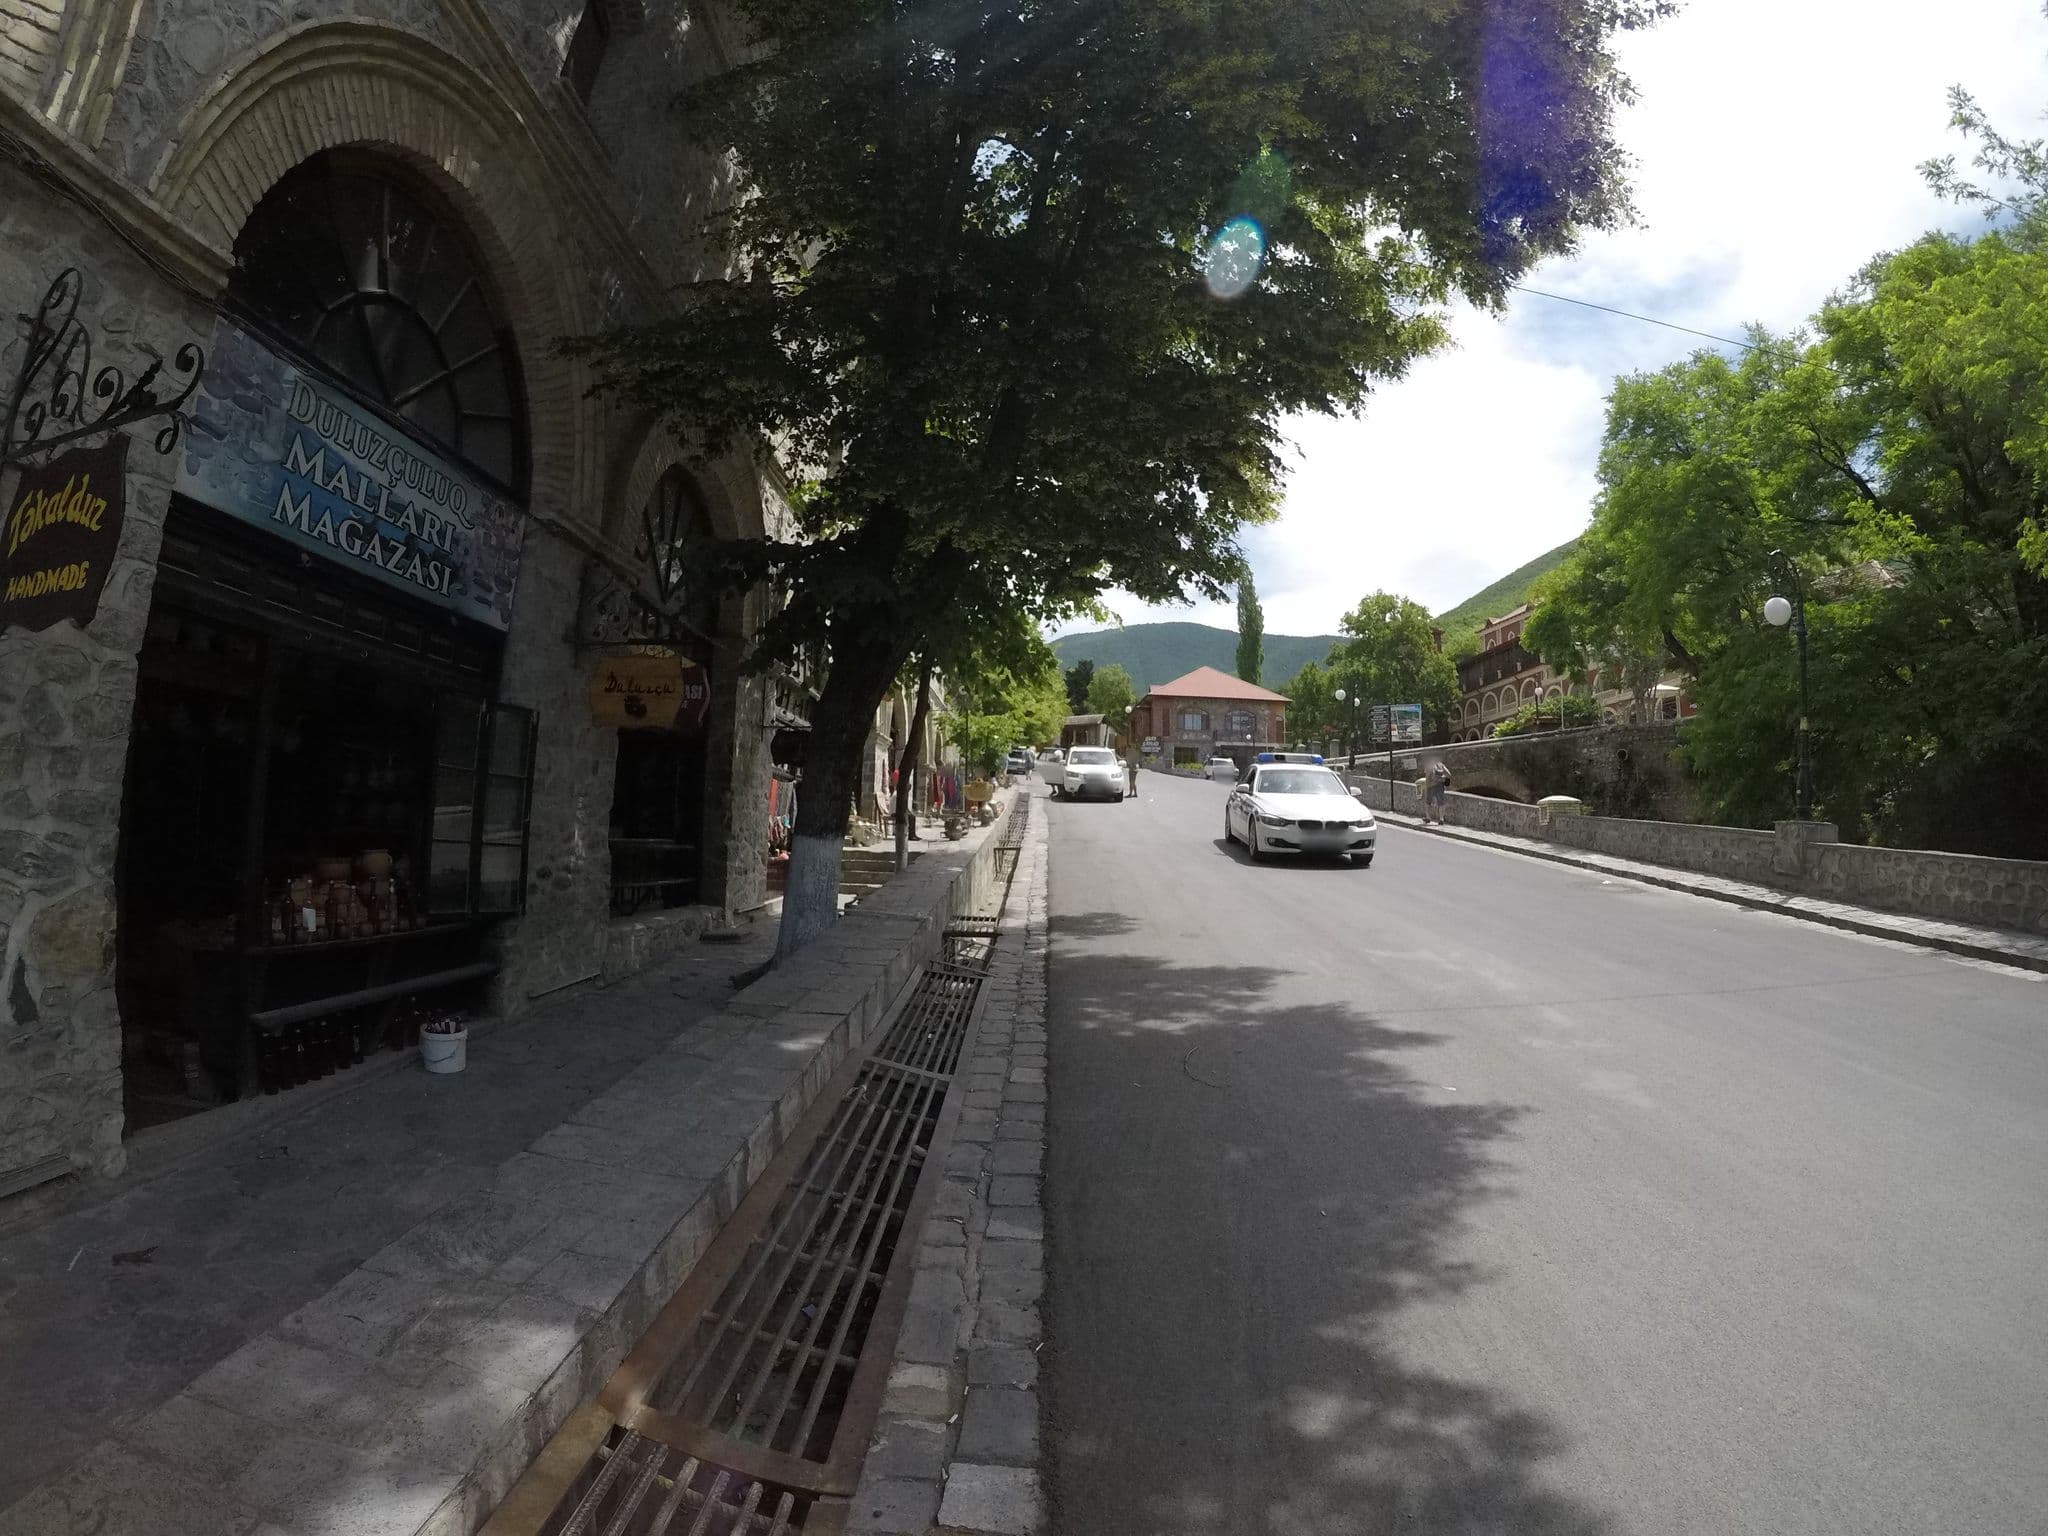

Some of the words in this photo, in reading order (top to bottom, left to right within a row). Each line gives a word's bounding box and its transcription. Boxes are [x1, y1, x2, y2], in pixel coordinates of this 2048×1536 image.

[282, 432, 456, 554] MALLARI
[288, 376, 474, 529] DULUZÇULUQ
[3, 560, 90, 604] HANDMADE
[270, 480, 452, 597] MAĞAZASI
